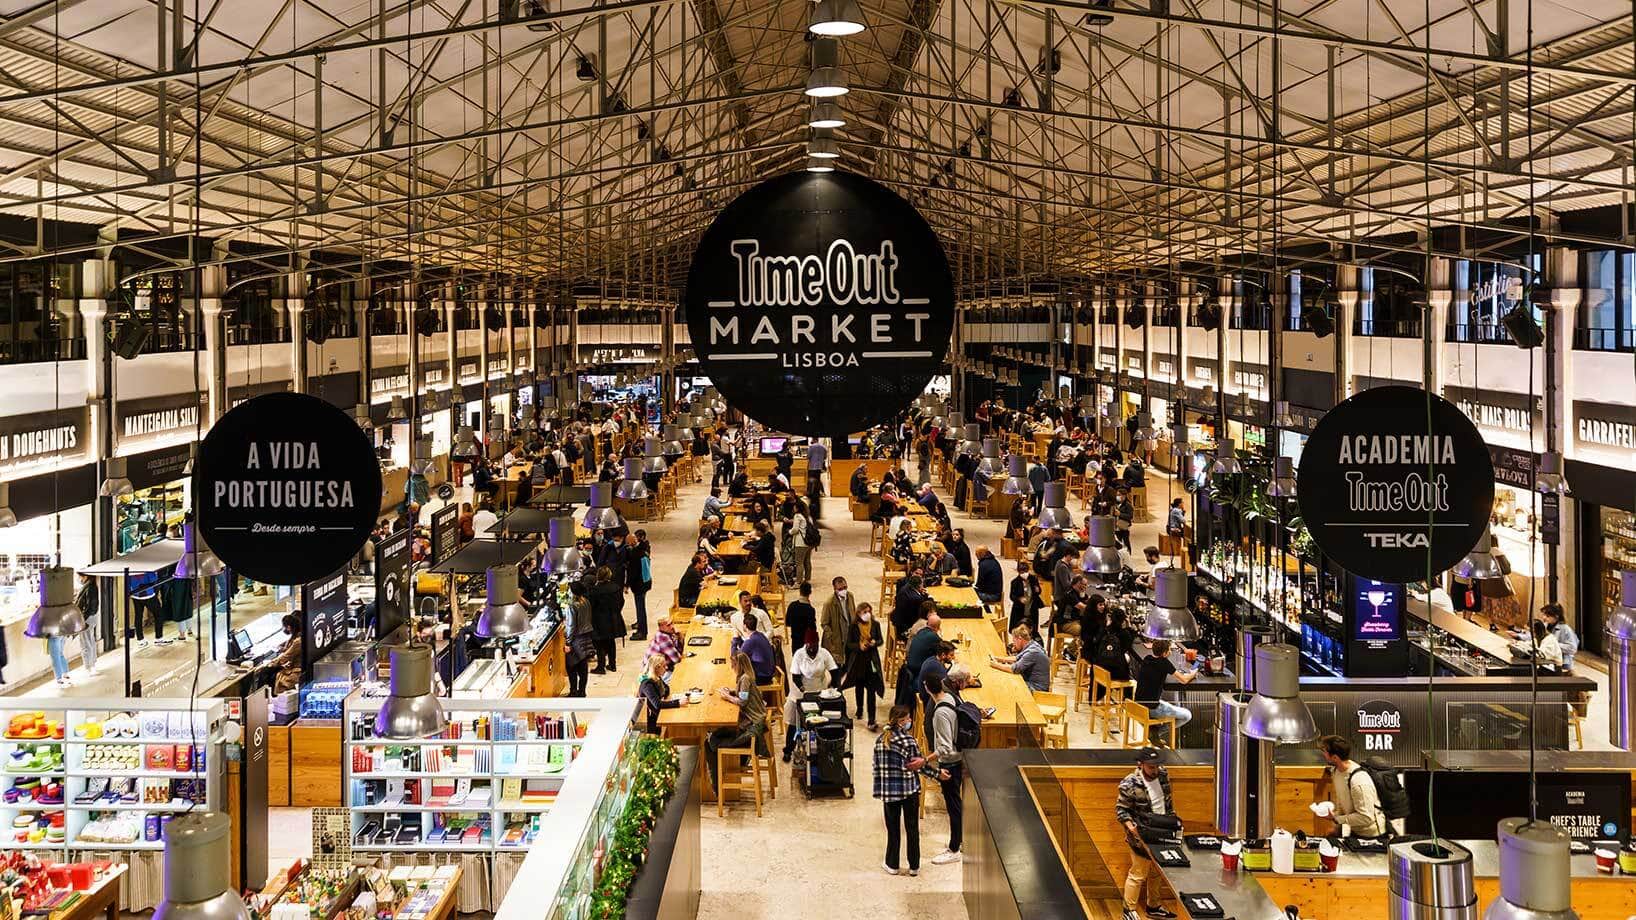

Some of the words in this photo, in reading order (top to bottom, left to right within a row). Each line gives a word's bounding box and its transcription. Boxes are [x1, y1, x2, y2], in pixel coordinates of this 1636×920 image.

[731, 239, 824, 306] Time
[826, 239, 900, 306] Out
[710, 313, 931, 345] MARKET
[783, 352, 860, 368] LISBOA
[125, 409, 179, 438] MANTEIGARIA
[1481, 404, 1503, 428] MAIS
[13, 425, 77, 458] DOUGHNUTS
[1579, 418, 1636, 449] GARRAFEI
[247, 442, 260, 470] A
[269, 442, 321, 470] VIDA
[1338, 435, 1456, 464] ACADEMIA
[1494, 467, 1529, 486] AVLOVA
[214, 480, 355, 508] PORTUGUESA
[1345, 471, 1404, 511] Time
[1404, 472, 1450, 511] Out
[251, 522, 281, 534] Desde
[281, 524, 317, 535] sempre
[1364, 532, 1431, 548] TEKA
[1357, 710, 1382, 728] Time
[1381, 710, 1401, 728] Out
[1365, 733, 1393, 751] BAR
[1550, 815, 1577, 827] CHEF'S
[1578, 815, 1602, 827] TABLE
[1561, 826, 1599, 838] ERIENCE
